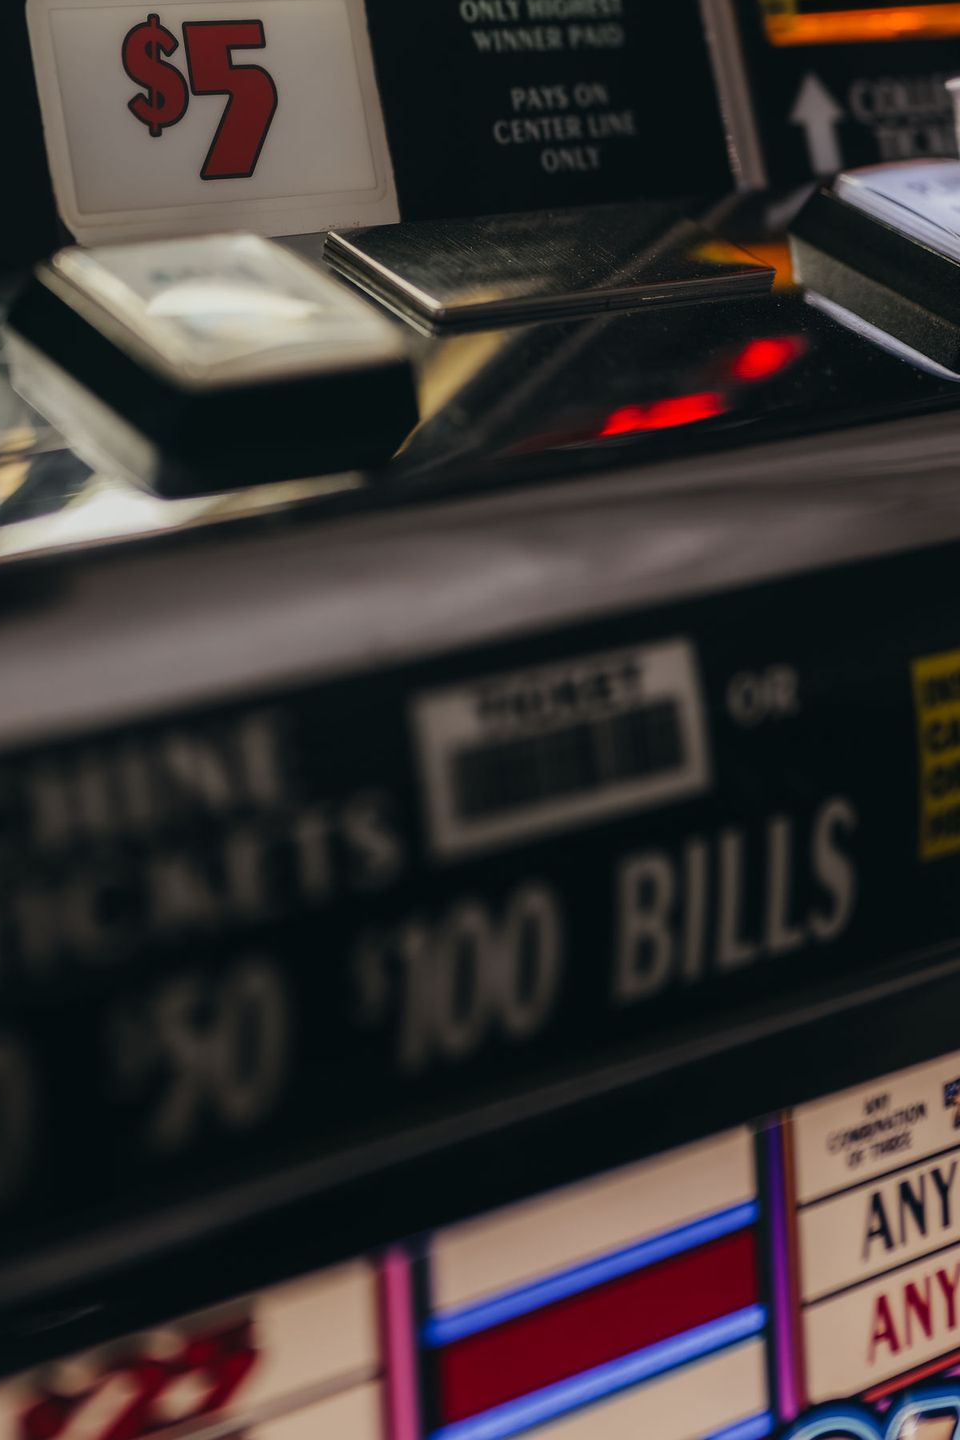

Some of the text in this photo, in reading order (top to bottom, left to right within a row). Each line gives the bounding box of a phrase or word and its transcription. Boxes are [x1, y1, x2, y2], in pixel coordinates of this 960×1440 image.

[471, 25, 565, 52] WINNER
[121, 13, 279, 181] $5
[493, 114, 583, 145] CENTER
[510, 81, 609, 112] PAYS ON
[541, 145, 601, 174] ONLY
[612, 794, 860, 1008] BILLS
[861, 1159, 959, 1263] ANY
[866, 1258, 960, 1366] ANY
